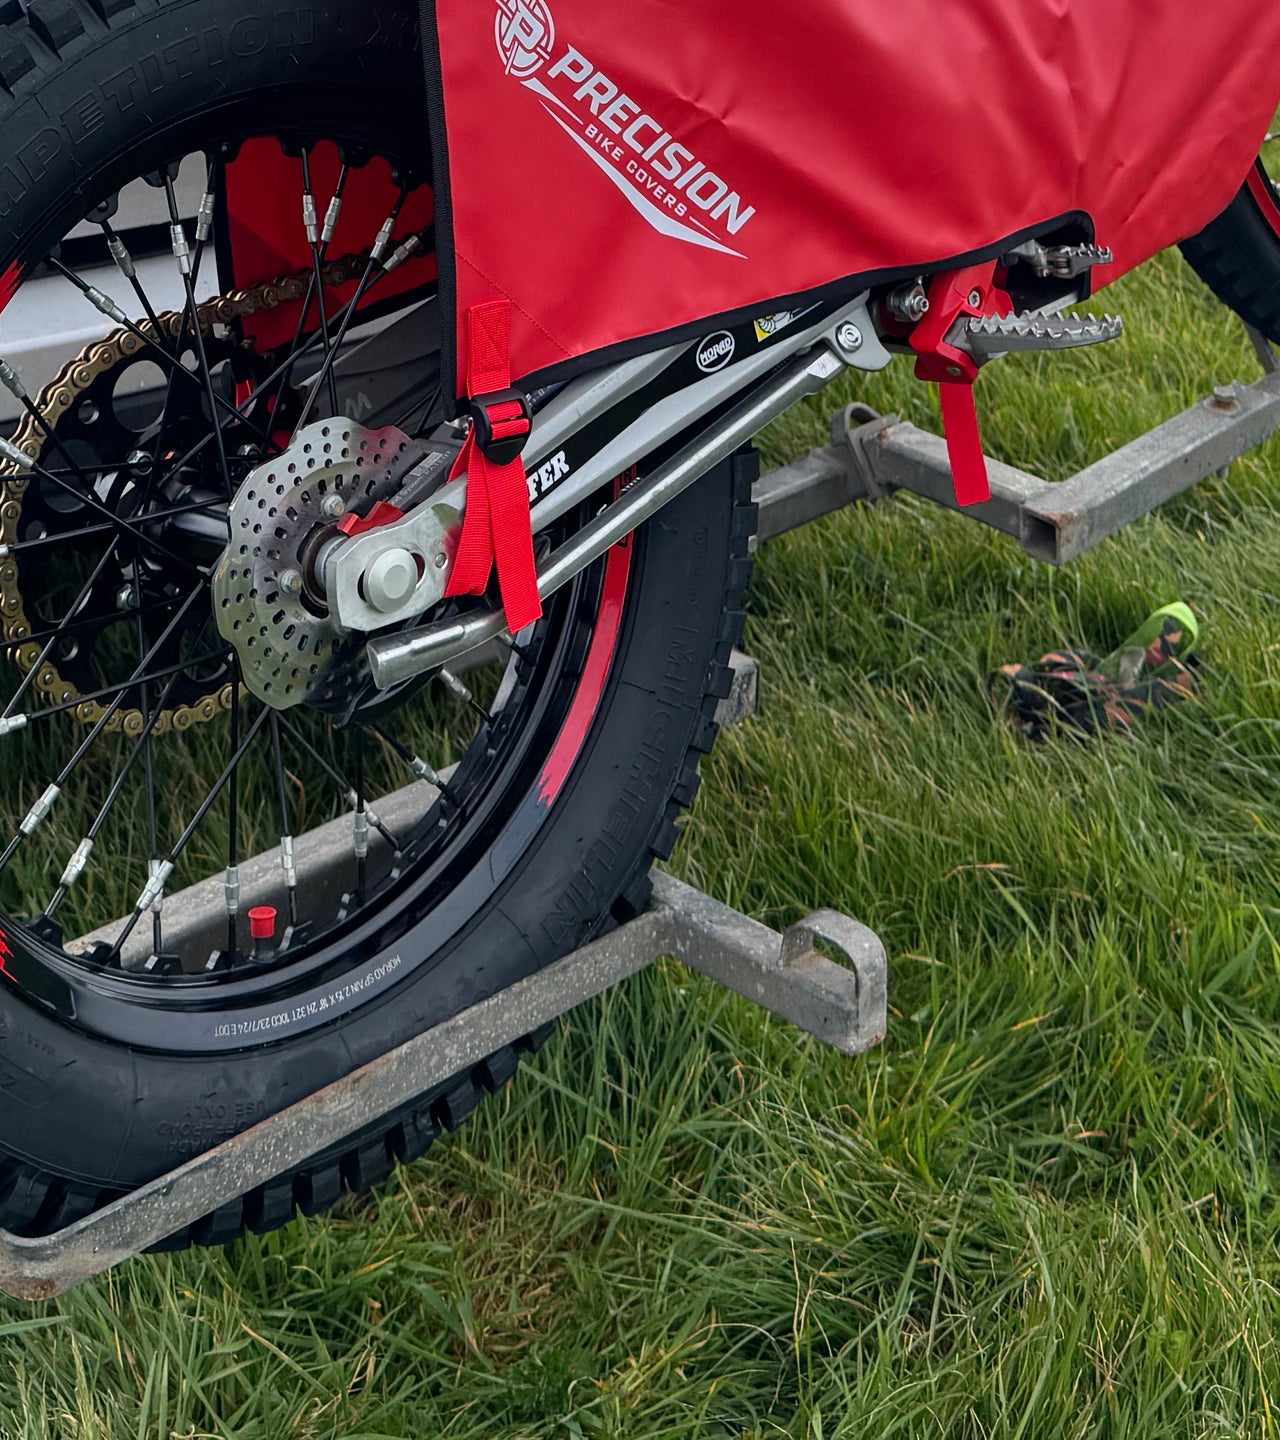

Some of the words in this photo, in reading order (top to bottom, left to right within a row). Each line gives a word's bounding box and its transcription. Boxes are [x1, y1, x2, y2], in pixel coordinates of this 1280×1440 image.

[548, 43, 756, 236] PRECISION
[585, 123, 625, 162] BIKE
[626, 159, 688, 217] COVERS
[700, 337, 732, 366] MORAD
[526, 450, 570, 502] FER
[351, 972, 375, 994] SPAIN
[373, 954, 402, 981] MORAD
